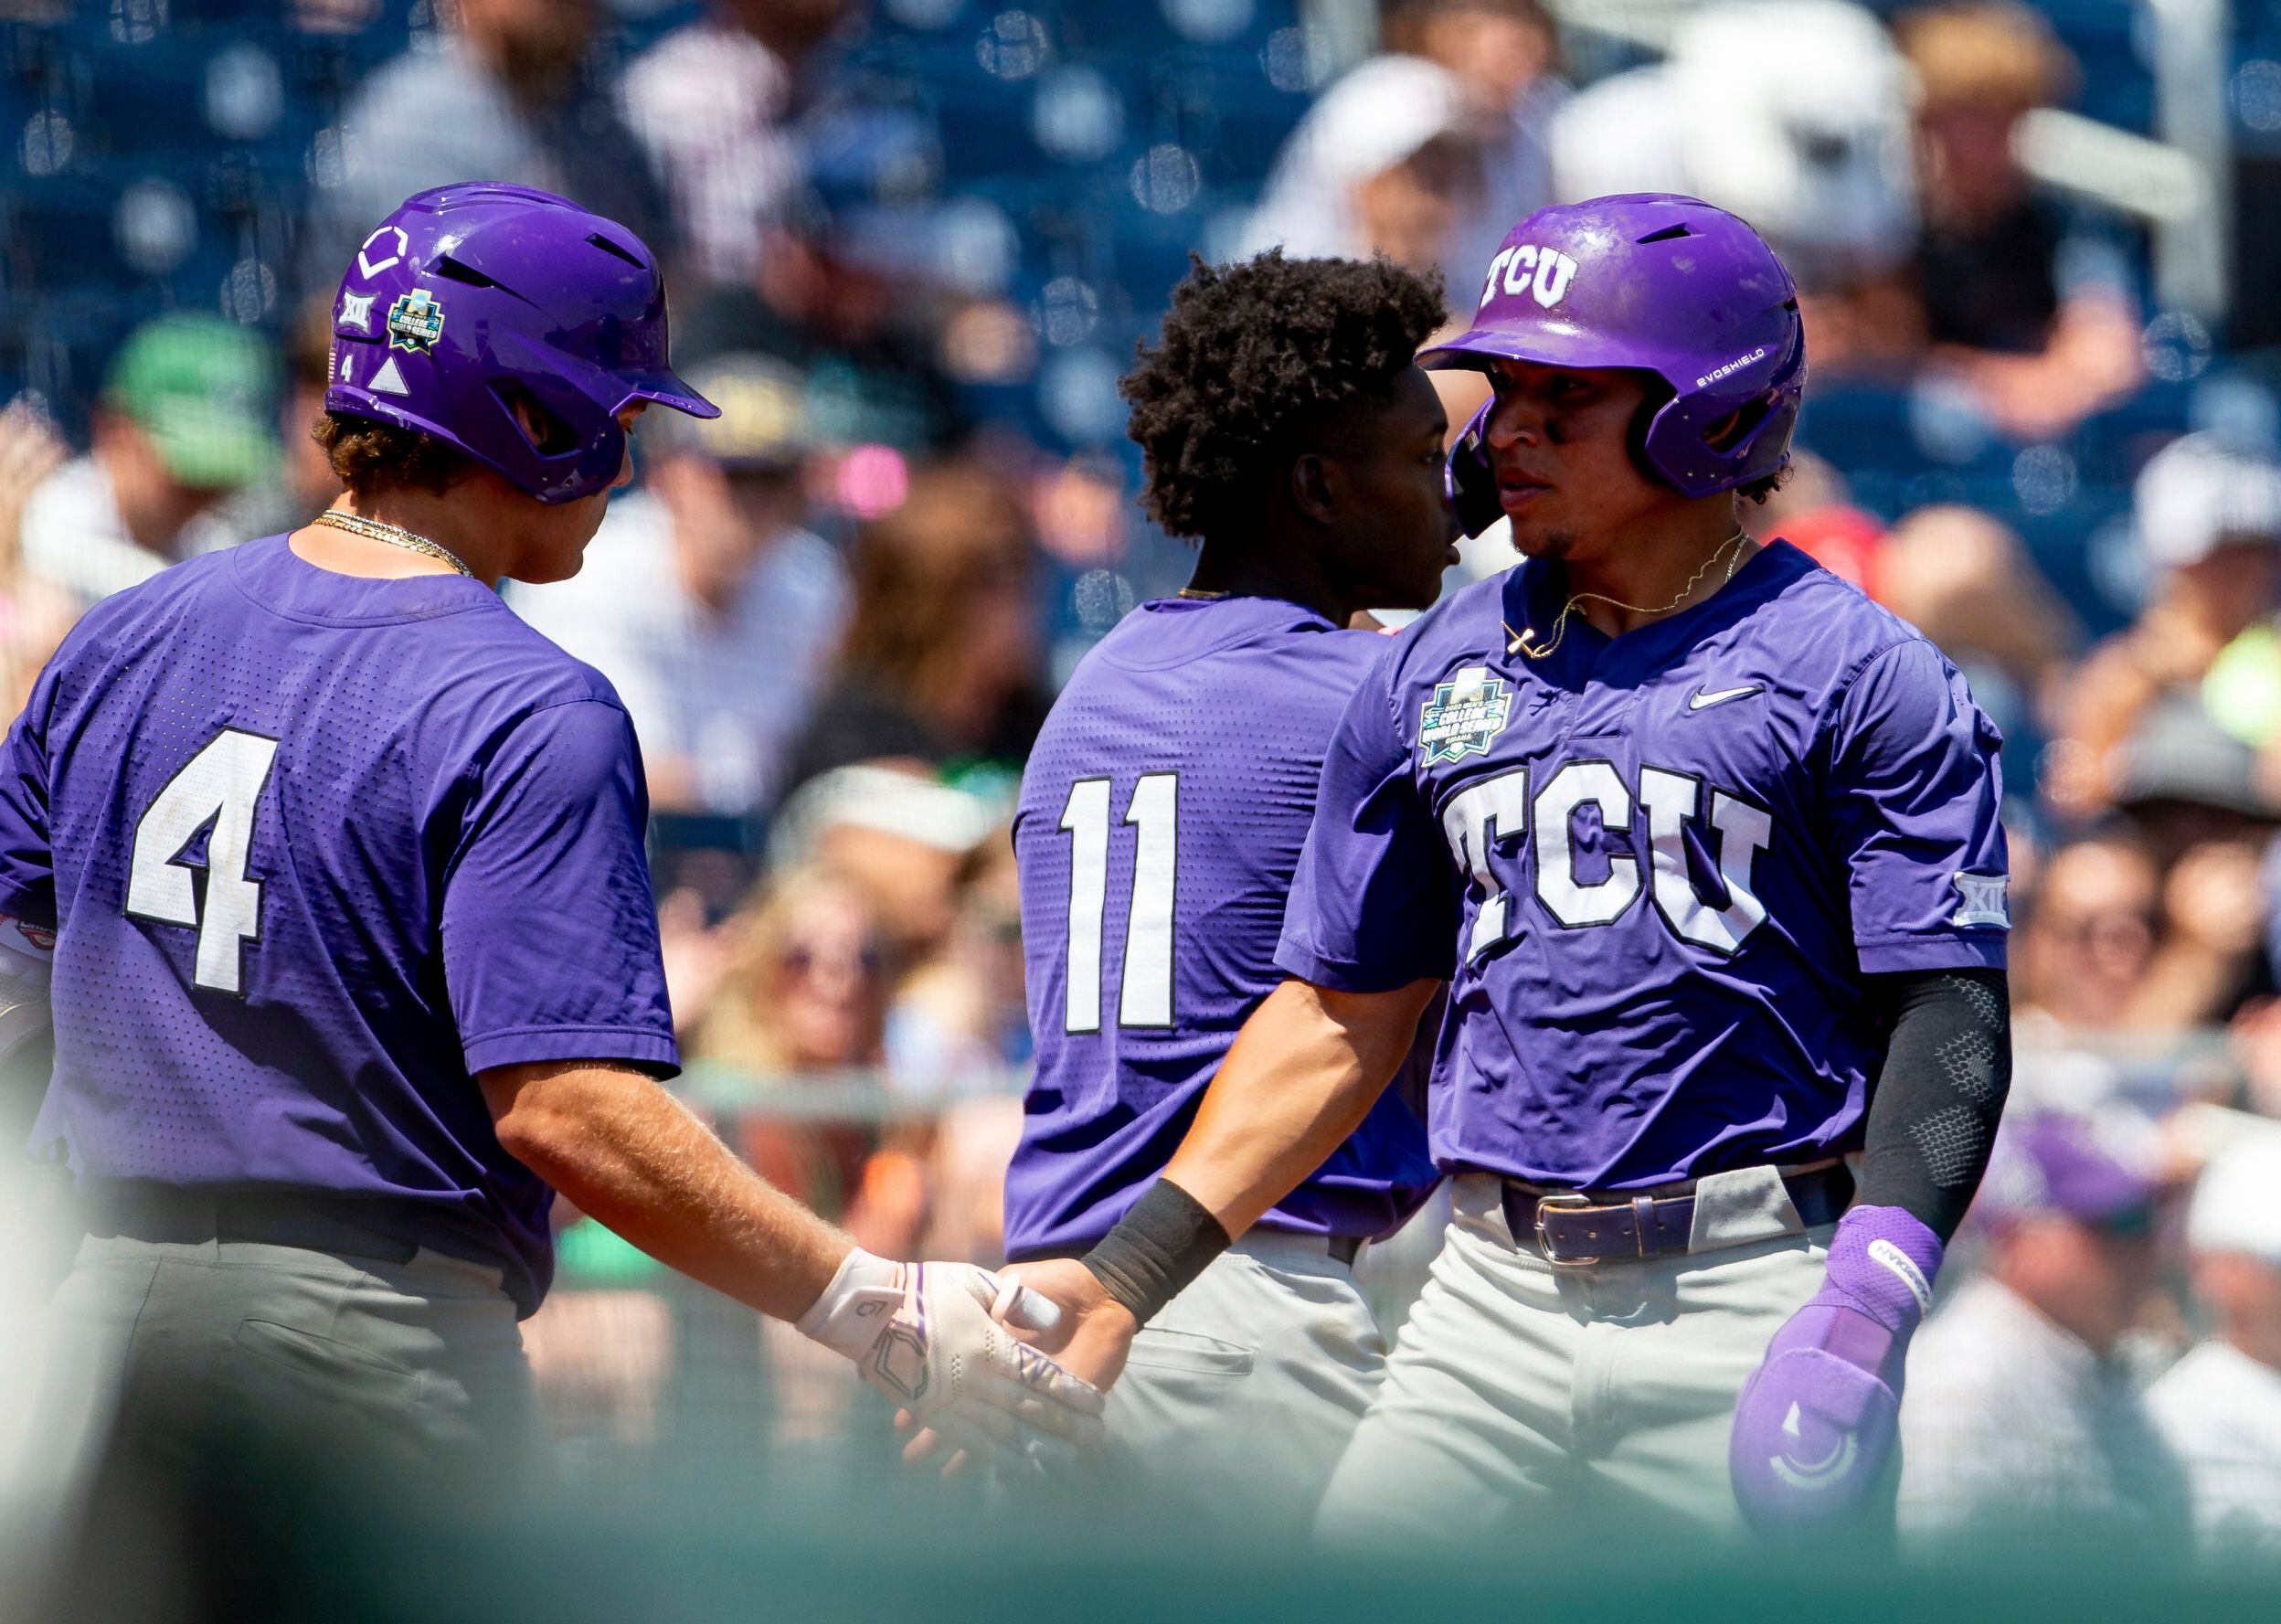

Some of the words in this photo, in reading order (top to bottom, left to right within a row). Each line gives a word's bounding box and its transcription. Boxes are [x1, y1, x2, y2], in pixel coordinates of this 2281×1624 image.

[340, 353, 355, 384] 4
[1480, 244, 1579, 312] TCU
[122, 726, 281, 997] 4
[1056, 771, 1179, 1036] 11
[1436, 758, 1773, 970] TCU
